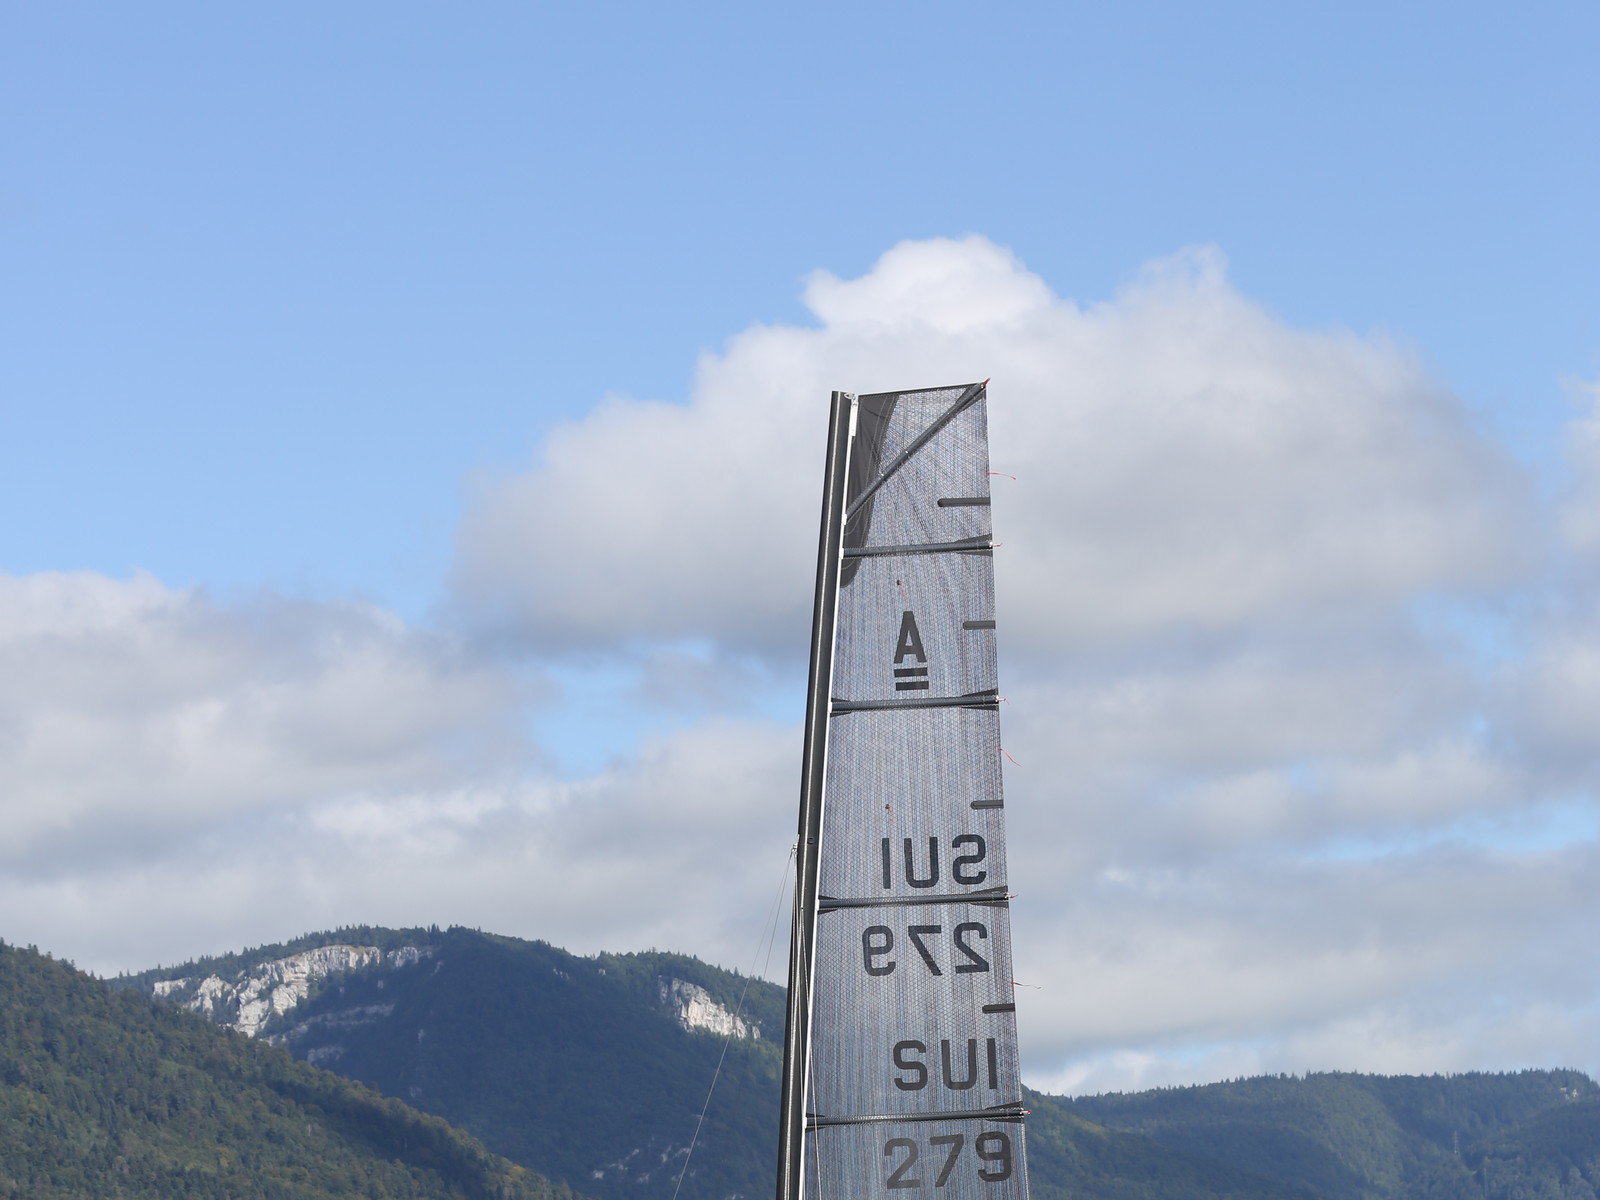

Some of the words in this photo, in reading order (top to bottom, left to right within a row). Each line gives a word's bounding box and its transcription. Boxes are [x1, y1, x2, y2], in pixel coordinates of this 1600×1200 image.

[893, 610, 927, 664] A
[893, 1038, 998, 1092] SUI
[884, 1131, 1012, 1190] 279
